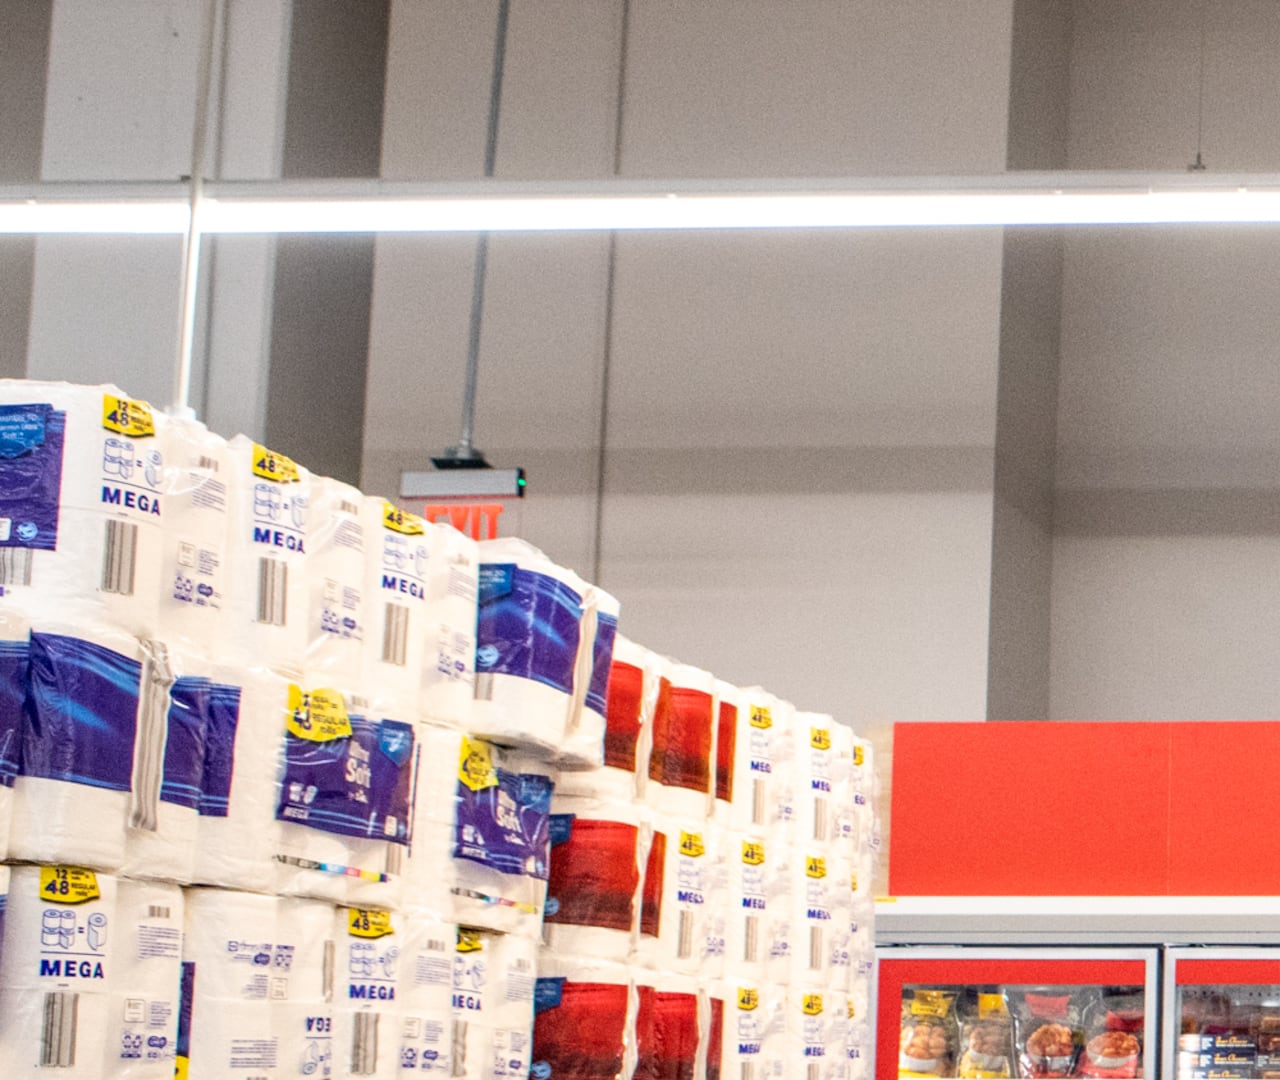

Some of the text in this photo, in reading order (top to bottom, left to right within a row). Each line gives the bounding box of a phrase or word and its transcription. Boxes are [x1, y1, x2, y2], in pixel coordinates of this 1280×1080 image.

[107, 409, 129, 426] 48
[102, 486, 160, 516] MEGA
[254, 527, 305, 554] MEGA
[55, 869, 68, 879] 12
[44, 880, 69, 895] 48
[352, 916, 370, 931] 48
[40, 959, 104, 979] MEGA
[349, 985, 395, 1000] MEGA
